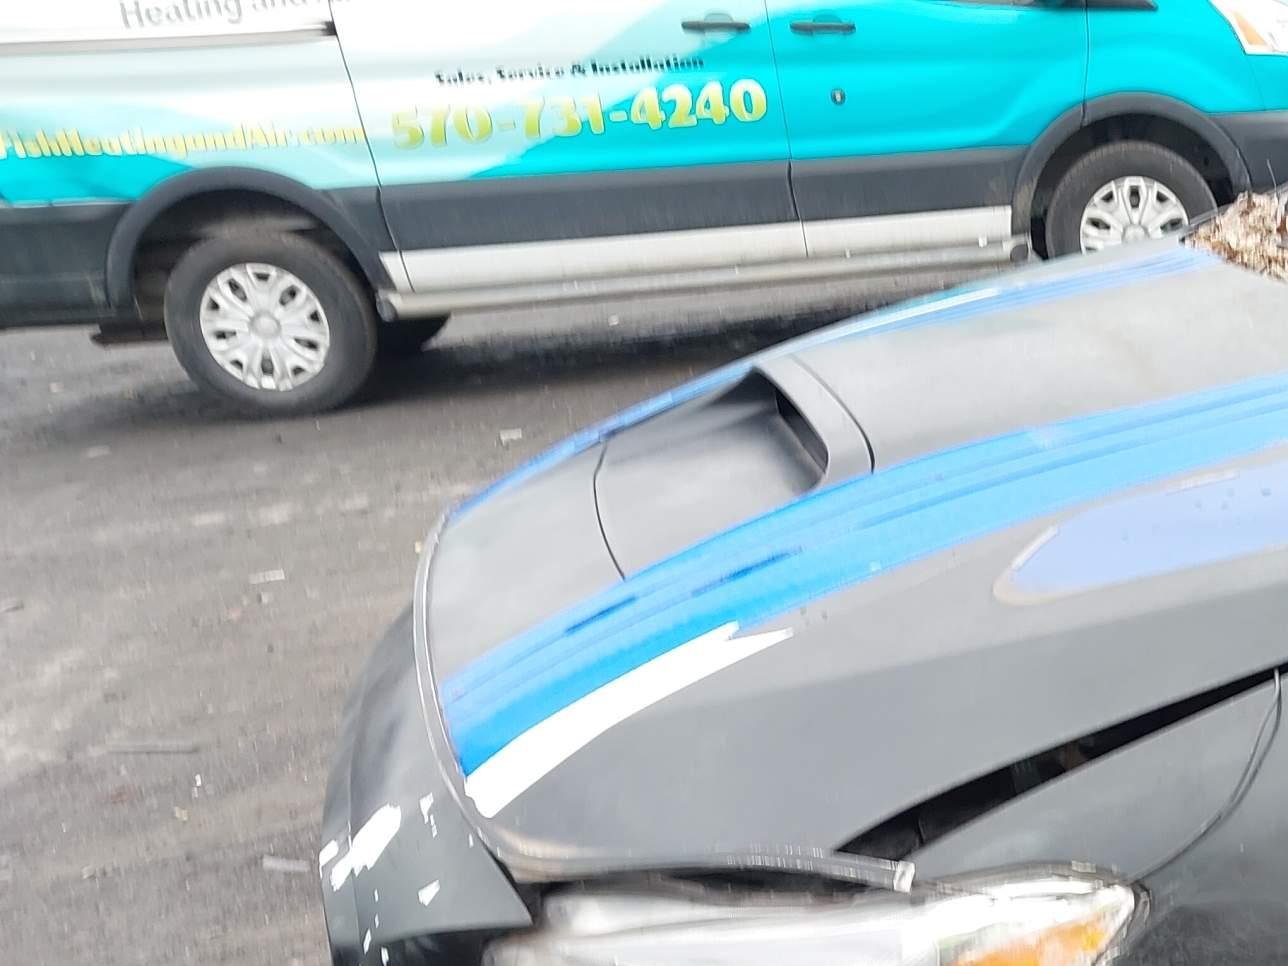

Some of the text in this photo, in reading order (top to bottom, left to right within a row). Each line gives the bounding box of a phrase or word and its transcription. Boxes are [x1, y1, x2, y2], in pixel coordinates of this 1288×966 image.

[496, 63, 565, 80] Service
[590, 55, 704, 74] Installation
[391, 78, 768, 149] 570-731-4240
